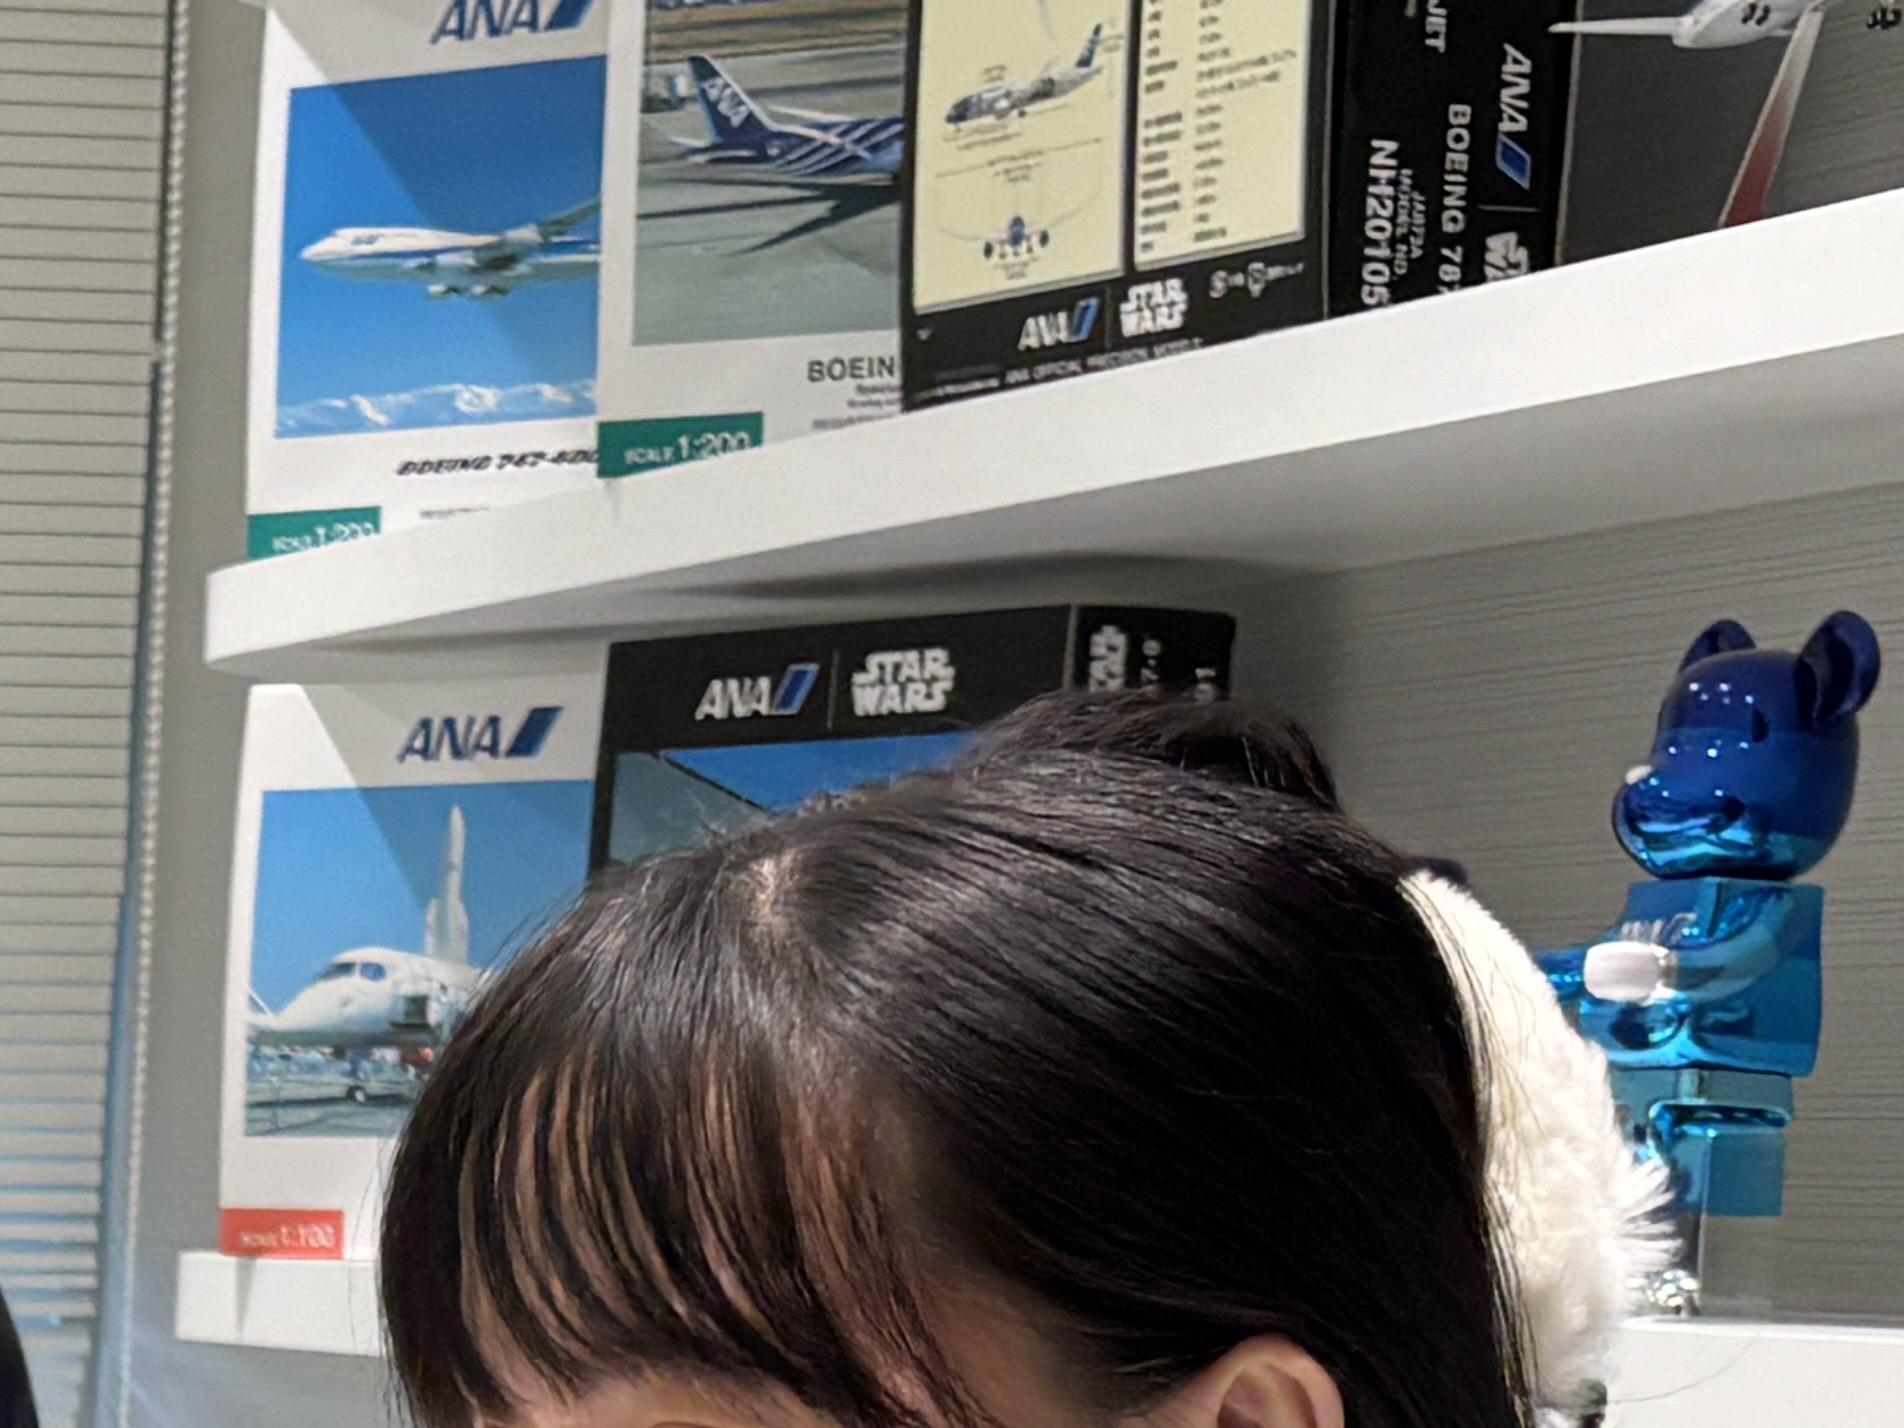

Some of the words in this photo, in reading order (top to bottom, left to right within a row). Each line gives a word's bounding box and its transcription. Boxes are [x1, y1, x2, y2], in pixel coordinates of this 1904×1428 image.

[430, 0, 542, 44] ANA
[1497, 43, 1532, 133] ANA
[1441, 104, 1472, 233] BOEING
[1361, 139, 1399, 306] NH20105
[1126, 278, 1188, 309] STAR
[1120, 301, 1187, 339] WARS
[807, 355, 897, 383] BOEIN
[676, 431, 751, 460] 1:200
[854, 648, 955, 684] STAR
[695, 677, 773, 721] ANA
[851, 679, 954, 716] WARS
[395, 714, 501, 764] ANA
